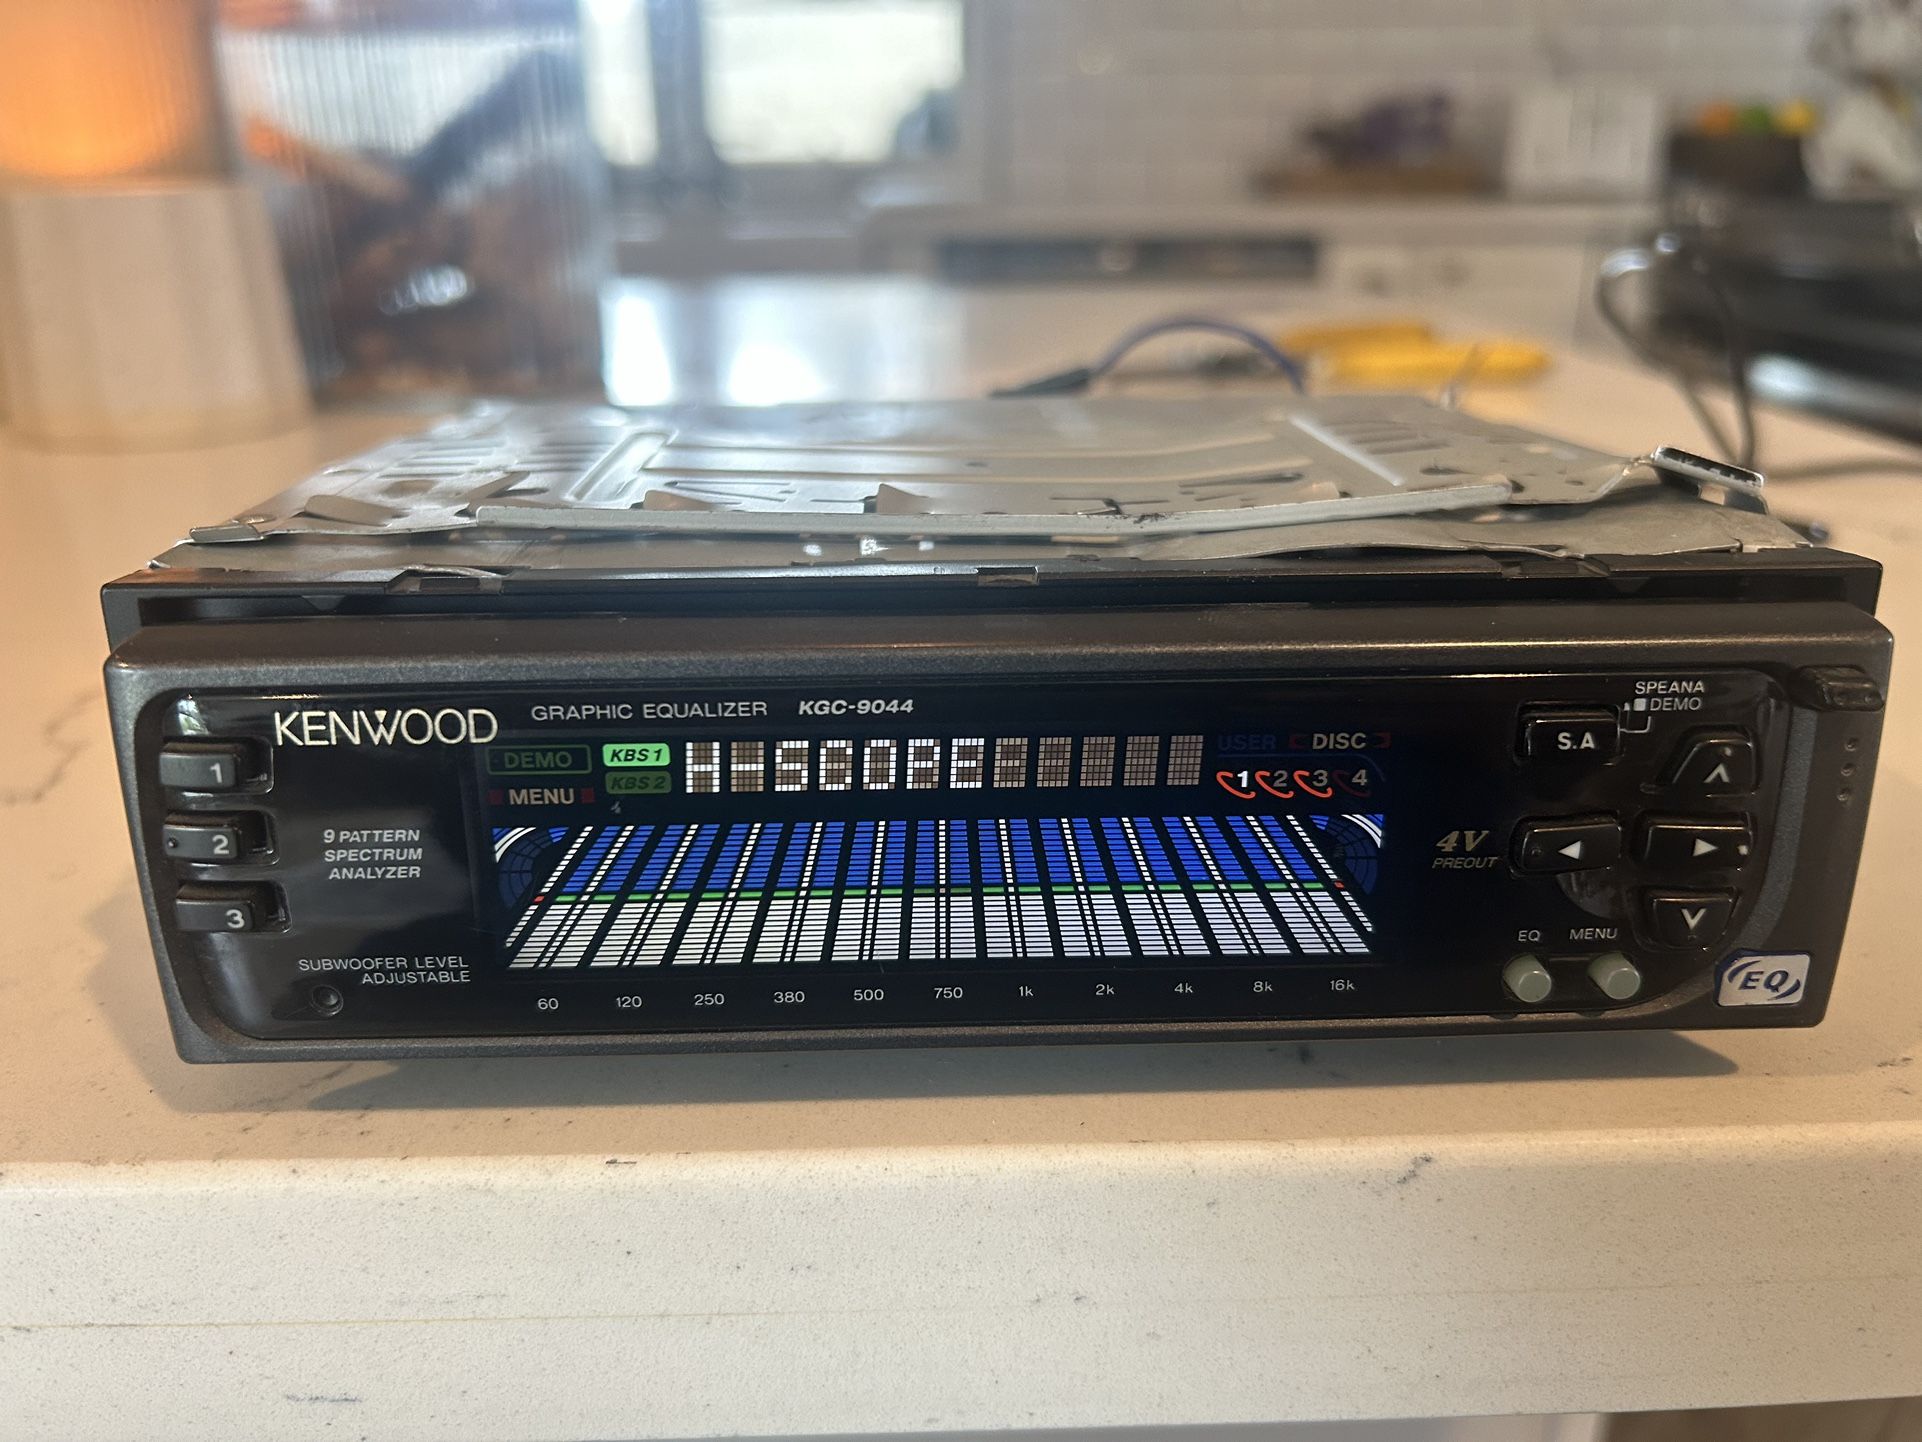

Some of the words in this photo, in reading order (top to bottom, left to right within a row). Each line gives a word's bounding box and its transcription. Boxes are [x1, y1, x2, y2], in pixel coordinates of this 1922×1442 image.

[1635, 681, 1704, 695] SPEANA
[531, 704, 633, 721] GRAPHIC
[643, 702, 767, 719] EQUALIZER
[798, 700, 914, 716] KGC-9044
[1650, 697, 1701, 711] DEMO
[274, 708, 498, 746] KENWOOD
[1217, 734, 1277, 751] USER
[1312, 732, 1367, 750] DISC
[1557, 732, 1595, 750] S.A
[504, 751, 572, 768] DEMO
[209, 763, 224, 784] 1
[1237, 770, 1249, 788] 1
[1273, 770, 1288, 787] 2
[1312, 769, 1328, 787] 3
[1352, 769, 1368, 786] 4
[509, 788, 574, 805] MENU
[323, 829, 335, 843] 9
[339, 829, 421, 843] PATTERN
[1435, 830, 1490, 852] 4V
[212, 835, 230, 855] 2
[323, 848, 423, 862] SPECTRUM
[1431, 856, 1498, 870] PREOUT
[328, 866, 421, 880] ANALYZER
[225, 910, 246, 929] 3
[1517, 928, 1542, 943] EQ
[1569, 927, 1618, 941] MENU
[298, 957, 409, 972] SUBWOOFER
[415, 955, 470, 969] LEVEL
[361, 970, 471, 985] ADJUSTABLE
[1737, 969, 1790, 992] EQ
[537, 997, 559, 1010] 60
[615, 995, 643, 1008] 120
[693, 992, 725, 1006] 250
[773, 990, 805, 1004] 380
[853, 988, 885, 1001] 500
[933, 986, 964, 999] 750
[1018, 985, 1034, 997] 1k
[1095, 984, 1115, 996] 2k
[1174, 982, 1194, 994] 4k
[1253, 980, 1273, 992] 8k
[1330, 979, 1355, 992] 16k
